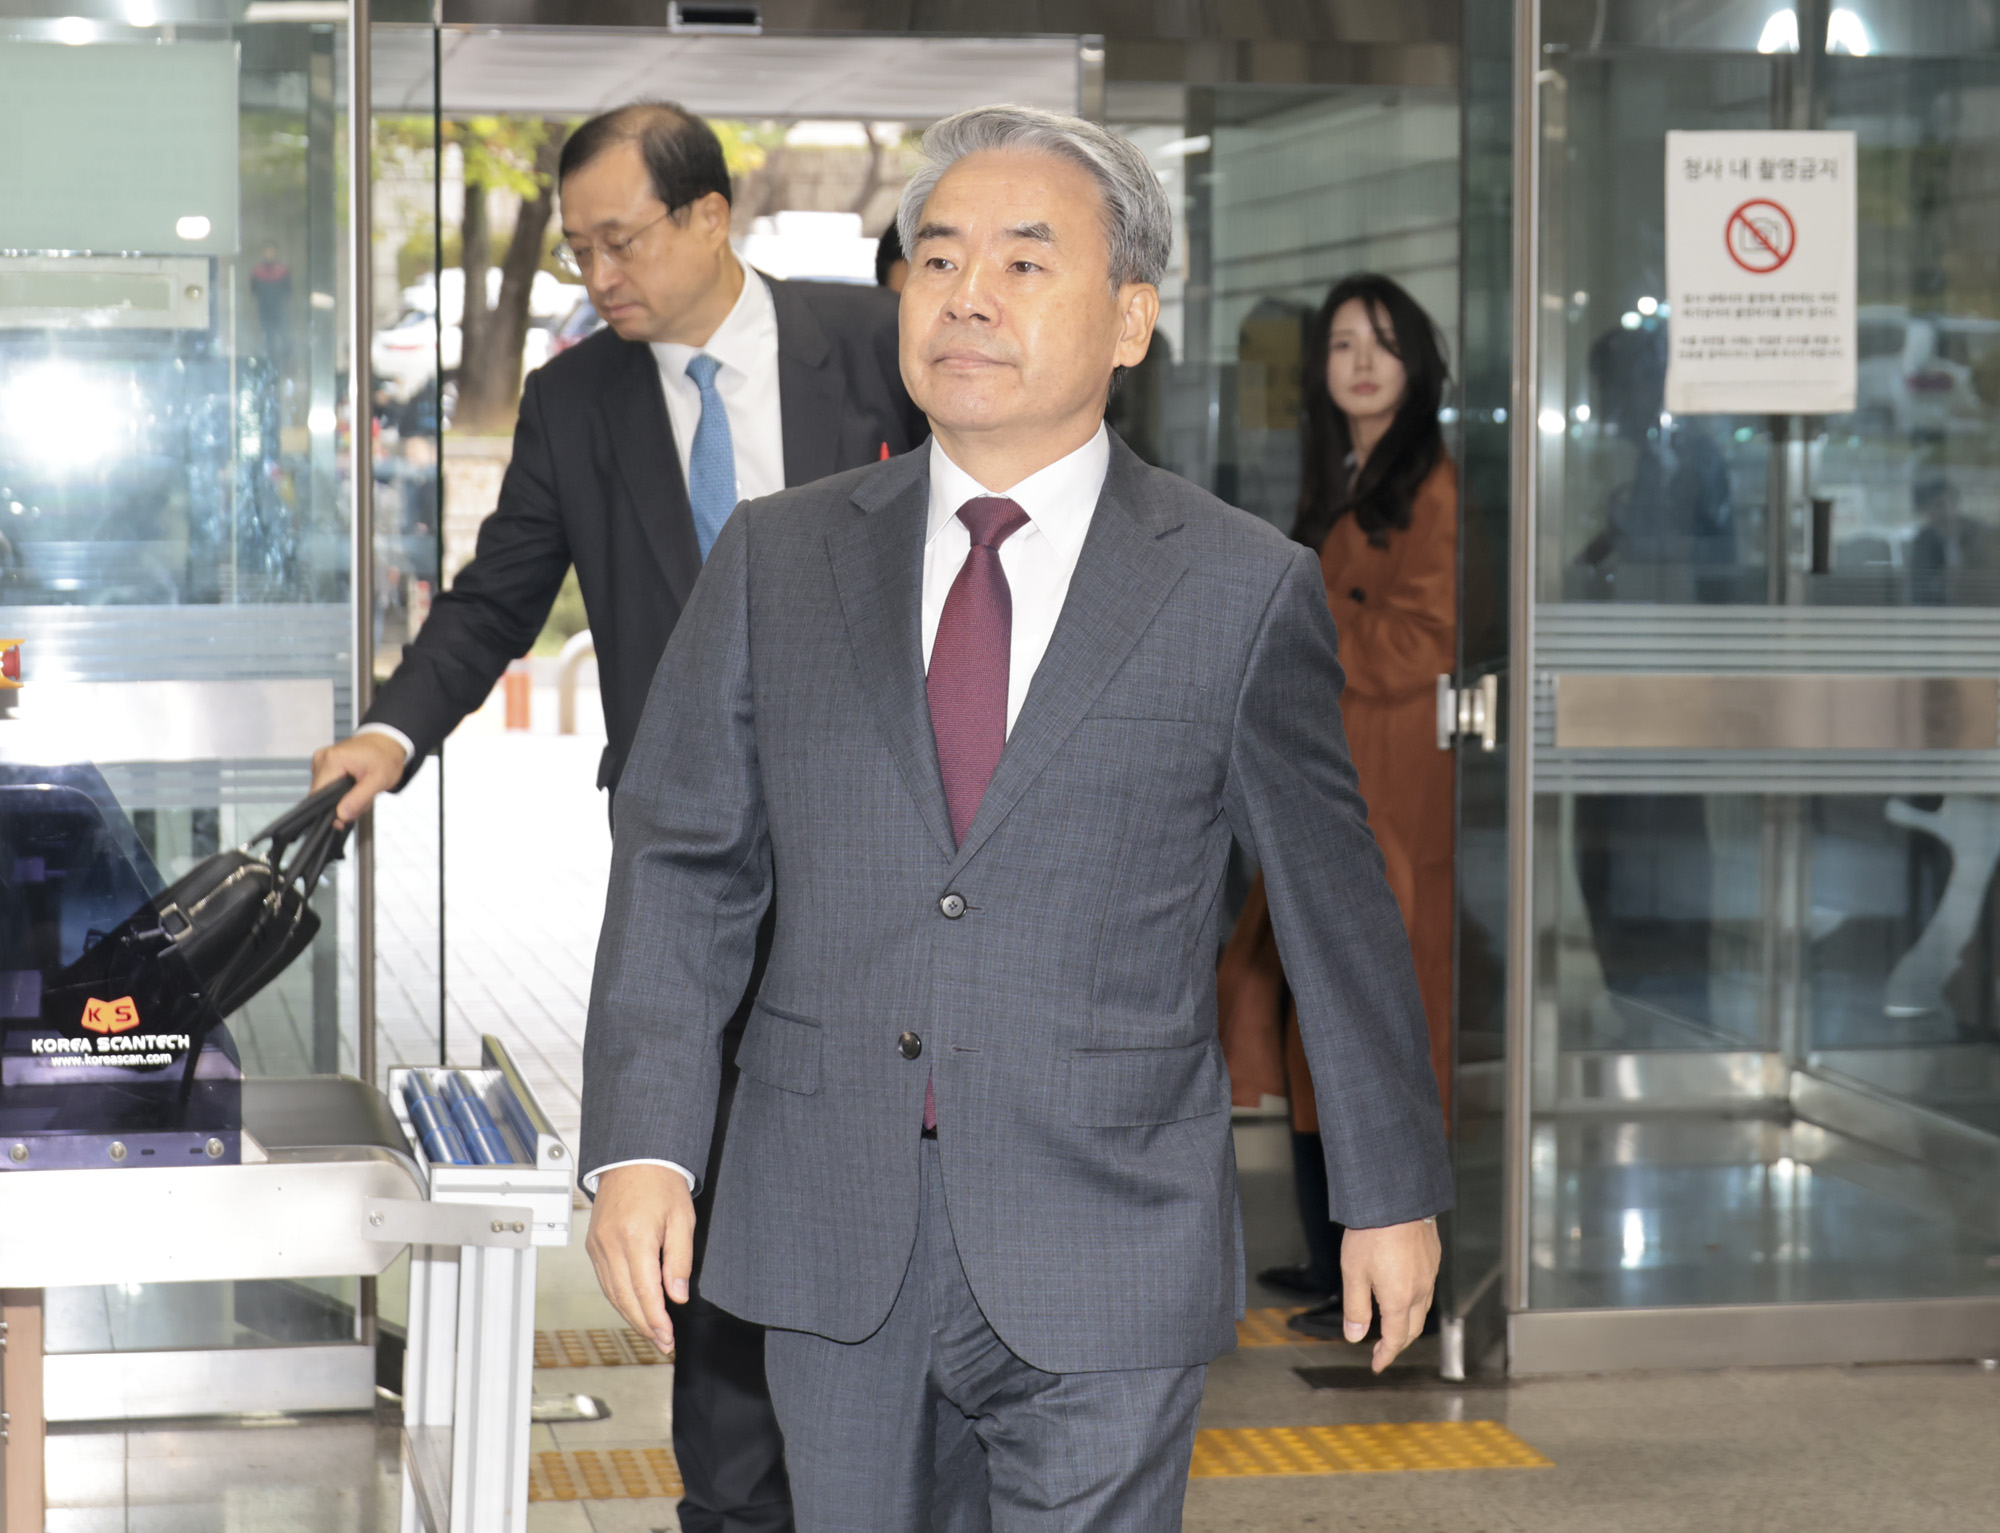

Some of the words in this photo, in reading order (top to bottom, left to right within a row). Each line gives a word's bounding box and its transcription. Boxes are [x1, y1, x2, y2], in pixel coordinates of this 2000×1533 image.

[1684, 156, 1723, 181] 청사
[1729, 156, 1750, 181] 내
[1759, 156, 1839, 181] 촬영금지
[87, 1005, 133, 1023] KS
[32, 1037, 93, 1054] KOREA
[97, 1034, 190, 1052] SCANTECH
[51, 1052, 172, 1067] www.koreascan.com
